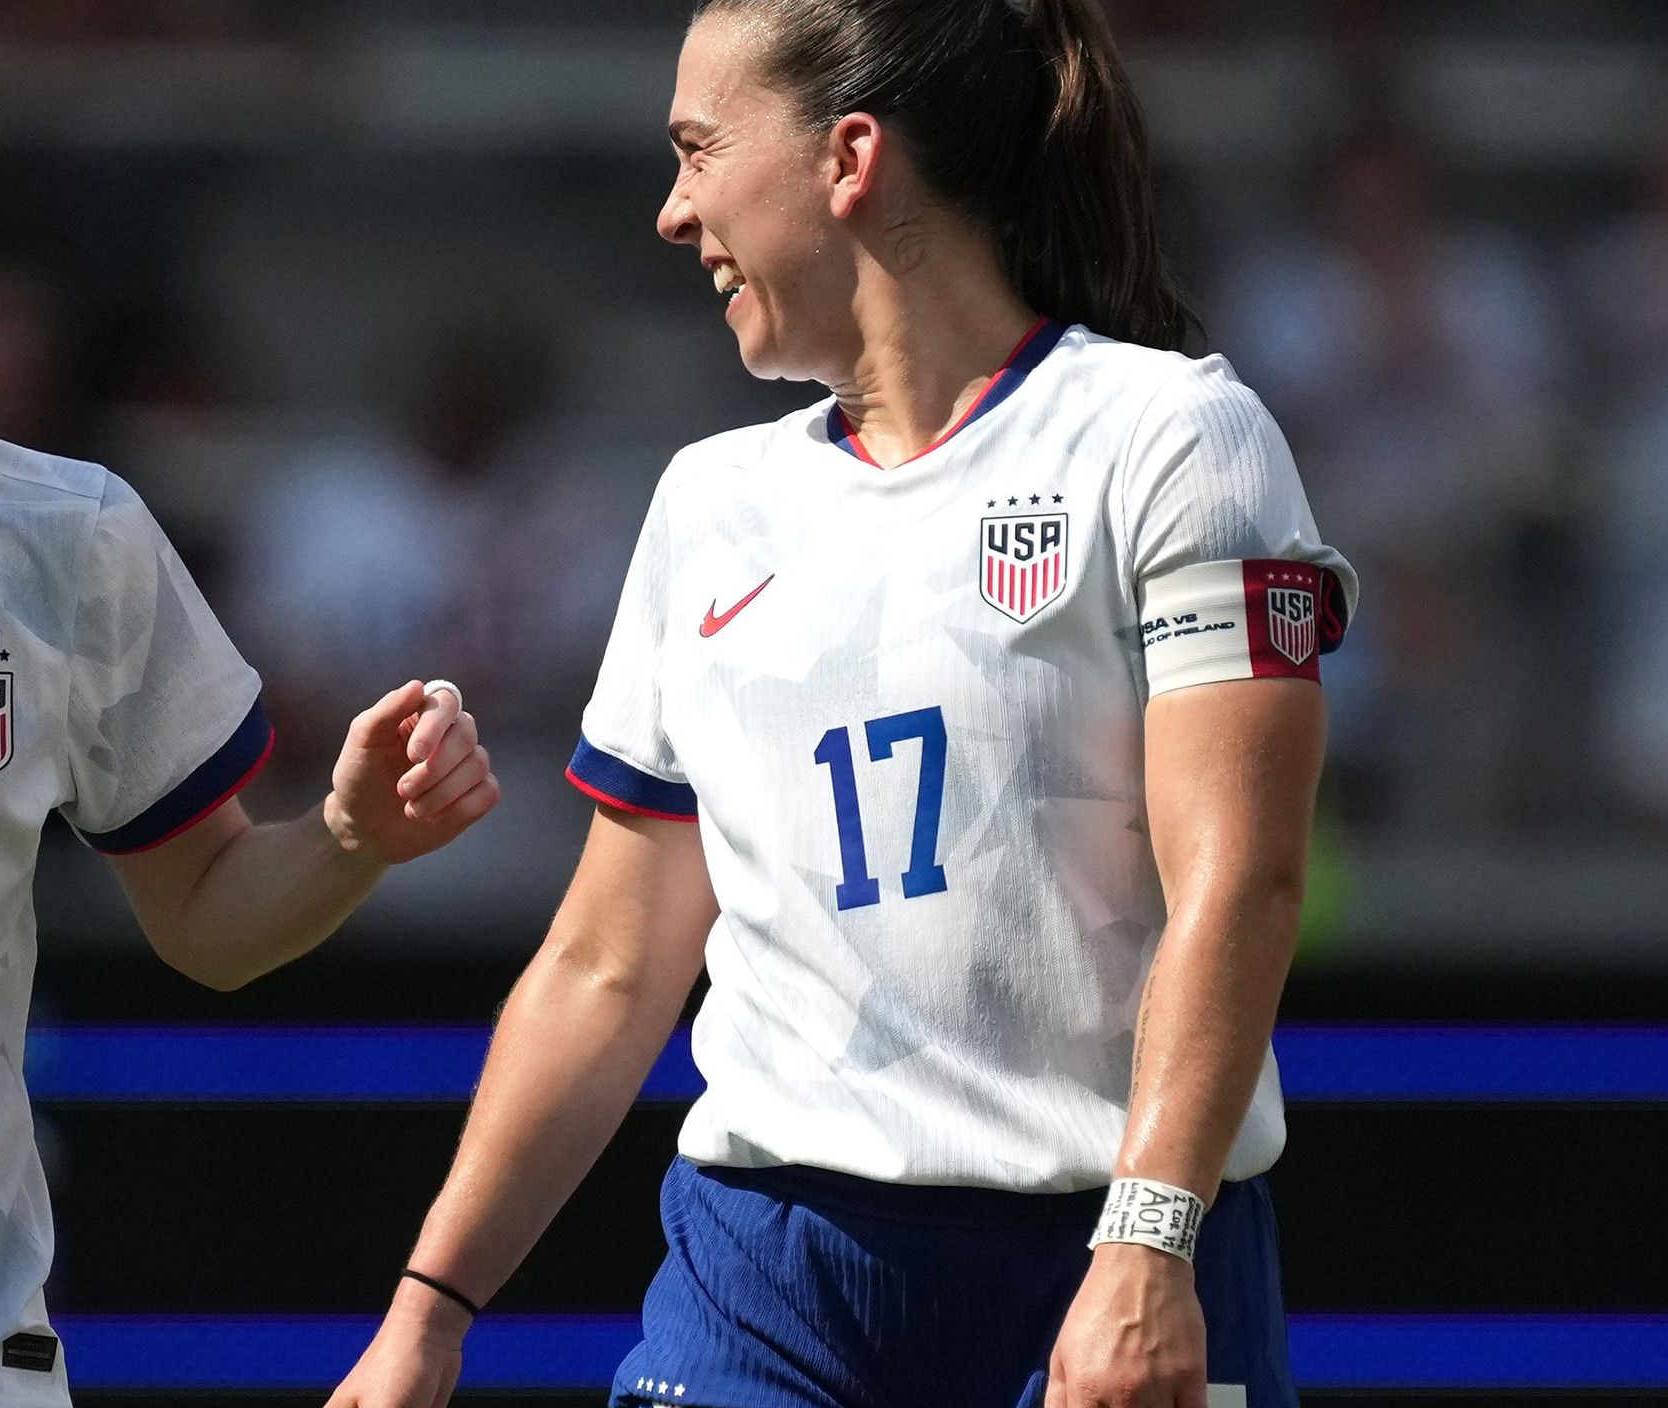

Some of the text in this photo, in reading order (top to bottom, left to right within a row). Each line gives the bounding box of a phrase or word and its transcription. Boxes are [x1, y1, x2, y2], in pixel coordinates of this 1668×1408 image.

[988, 520, 1061, 561] USA
[1271, 591, 1313, 621] USA
[1140, 617, 1169, 634] SA
[1156, 621, 1235, 642] OF IRELAND
[813, 705, 948, 911] 17
